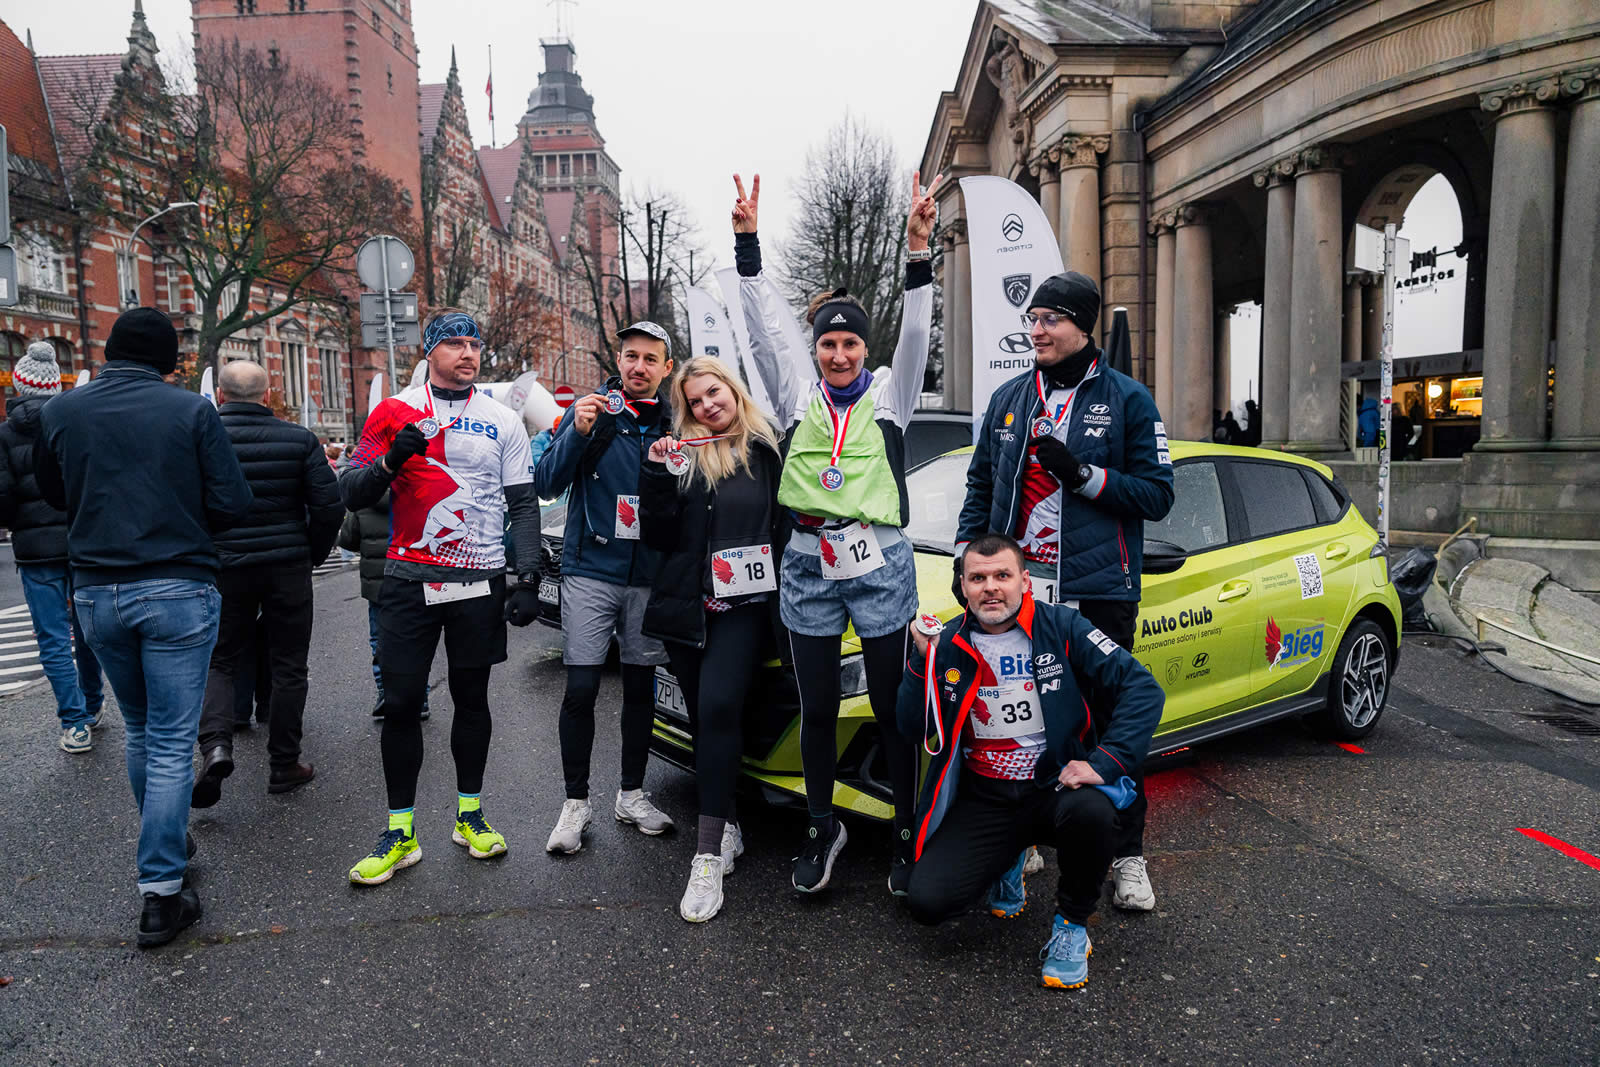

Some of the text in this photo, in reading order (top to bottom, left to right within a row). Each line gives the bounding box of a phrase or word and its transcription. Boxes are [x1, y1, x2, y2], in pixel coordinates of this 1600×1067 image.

[609, 397, 621, 406] 80
[423, 422, 436, 432] 80
[450, 416, 498, 440] Bieg
[1039, 422, 1052, 434] 80
[827, 471, 840, 482] 80
[722, 550, 743, 559] Bieg
[849, 539, 871, 563] 12
[744, 562, 765, 581] 18
[1141, 606, 1213, 638] Auto Club
[1131, 638, 1176, 655] autoryzowane
[1176, 632, 1197, 643] salony
[1201, 626, 1223, 638] serwisy
[1281, 628, 1325, 659] Bieg
[1000, 654, 1033, 676] Bie
[1037, 663, 1063, 675] YUNDAI
[1037, 669, 1063, 680] OTORSPORT
[657, 680, 679, 710] ZPL
[977, 688, 1000, 699] Bieg
[1001, 700, 1033, 724] 33
